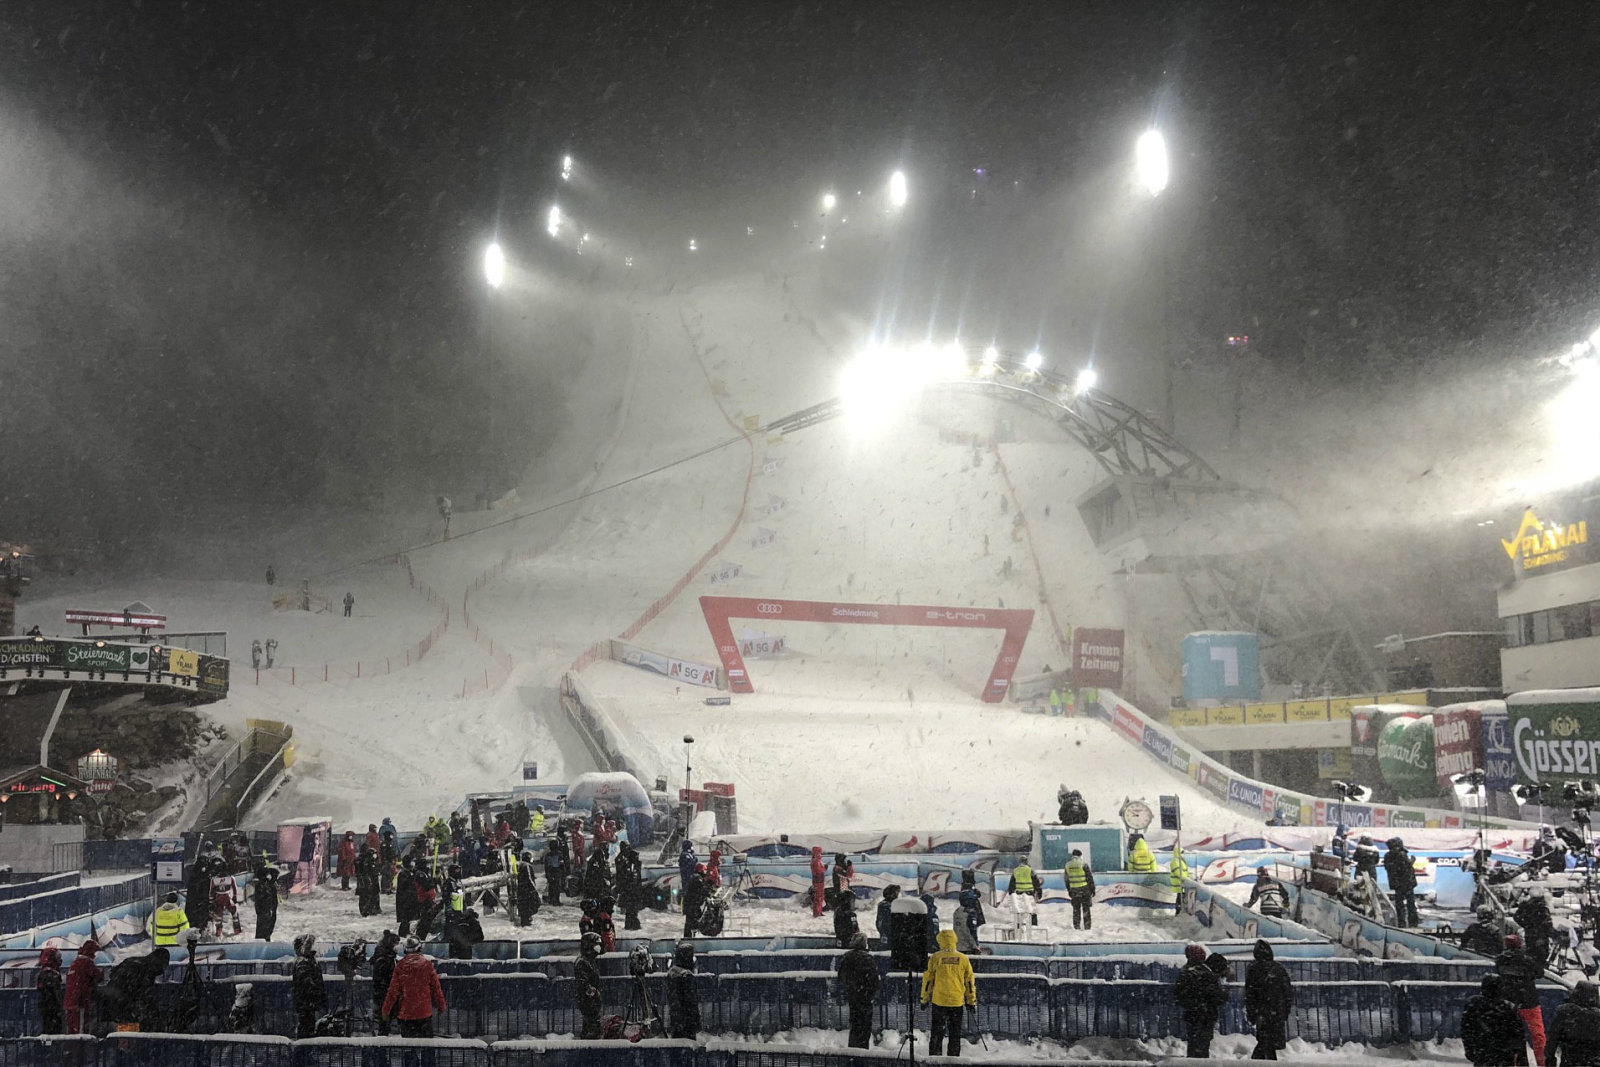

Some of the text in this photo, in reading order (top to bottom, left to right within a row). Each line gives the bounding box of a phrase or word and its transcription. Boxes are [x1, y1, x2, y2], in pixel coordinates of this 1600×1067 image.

[1522, 521, 1587, 557] PLANAI
[832, 607, 986, 621] Schladming e-tron
[0, 644, 56, 654] CHLADMING
[67, 646, 125, 666] Steiermark
[756, 643, 769, 653] 5G
[1081, 642, 1120, 656] Kronen
[1080, 656, 1120, 672] Zeitung
[670, 662, 714, 684] A1 5G A1
[1514, 717, 1600, 783] Gösser
[1239, 786, 1261, 806] UNIQA
[1341, 811, 1370, 827] UNIQA
